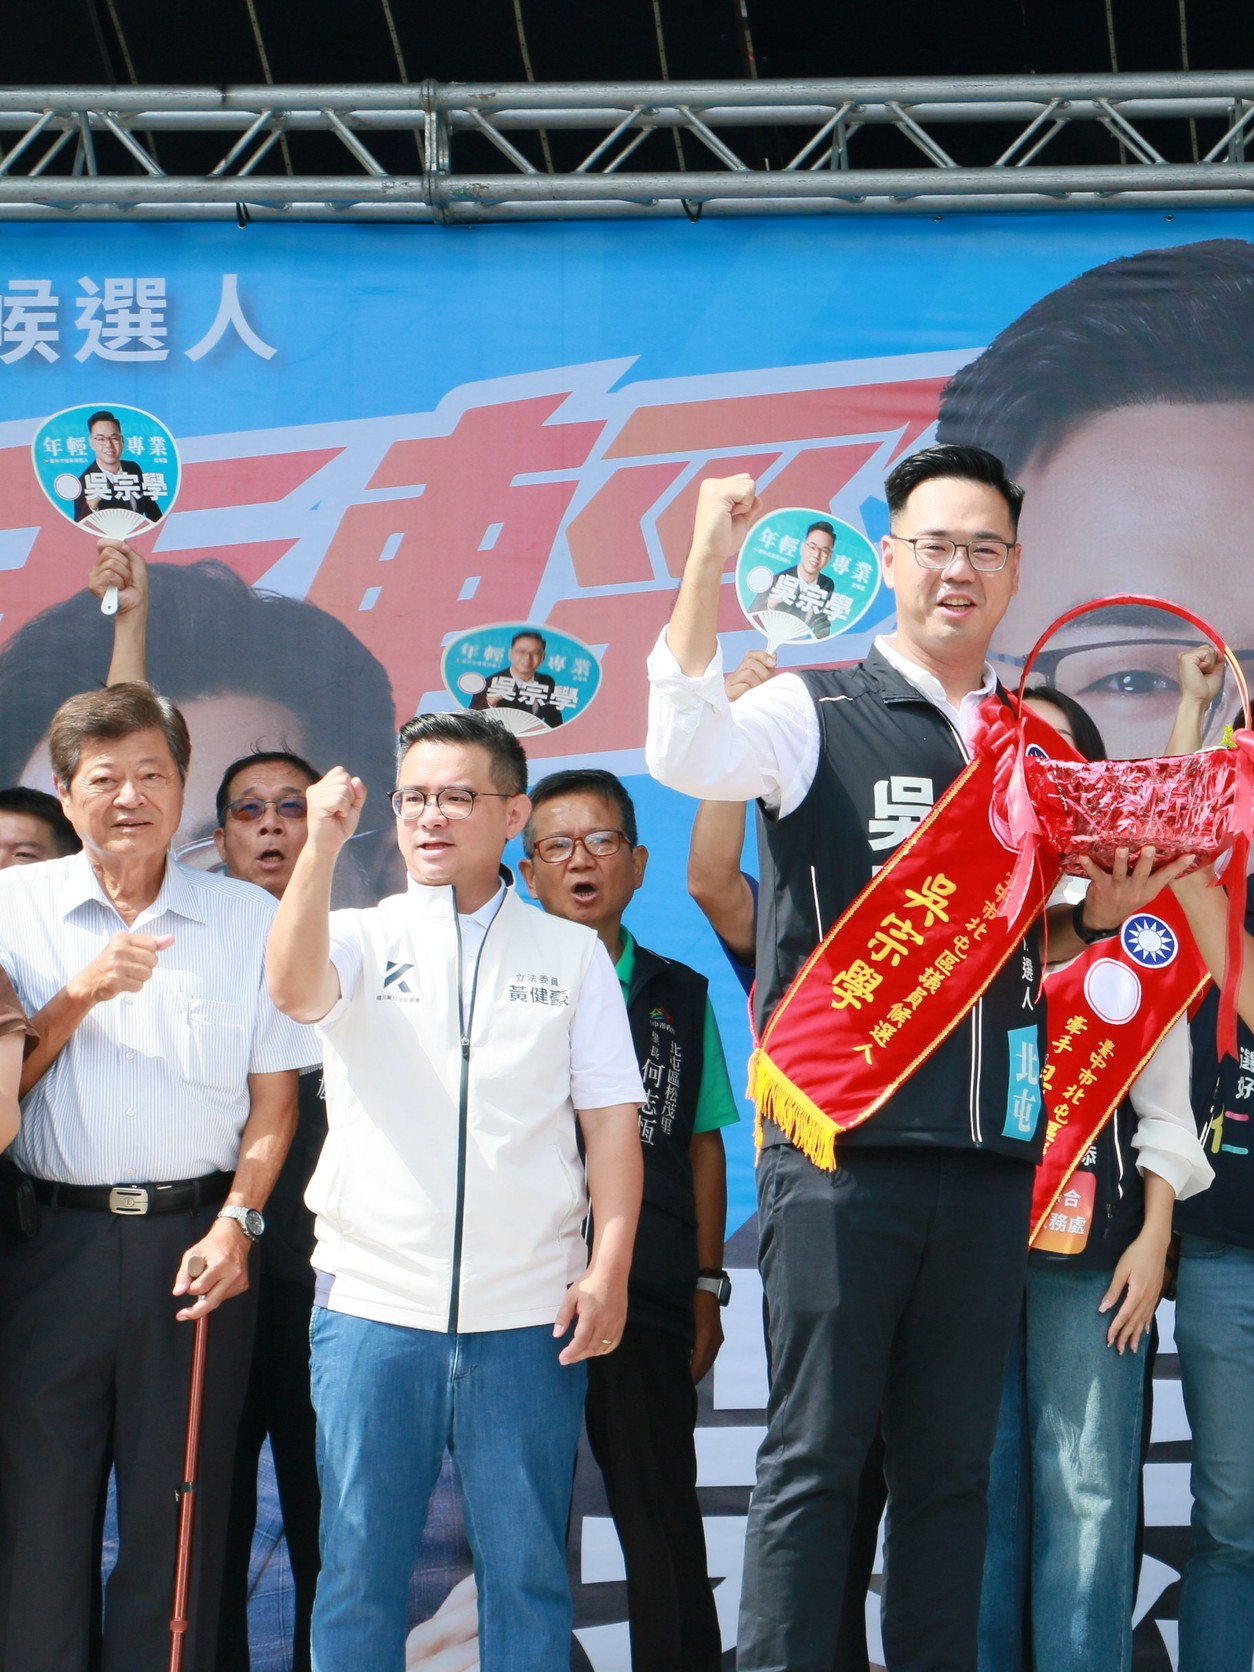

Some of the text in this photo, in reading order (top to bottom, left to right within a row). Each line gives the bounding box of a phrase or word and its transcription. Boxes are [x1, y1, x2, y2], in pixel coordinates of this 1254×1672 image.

[43, 436, 168, 456] 年輕 專業
[84, 472, 168, 501] 吳宗學
[759, 527, 799, 557] 年輕
[832, 554, 873, 584] 專業
[770, 574, 854, 620] 吳宗學
[486, 676, 579, 710] 吳宗學
[832, 873, 957, 1010] 吳宗學
[516, 973, 559, 987] 立法委員
[1021, 937, 1035, 1011] 選人
[509, 985, 569, 1006] 黃健豪
[1013, 1041, 1038, 1132] 北屯
[1044, 1214, 1085, 1234] 務處
